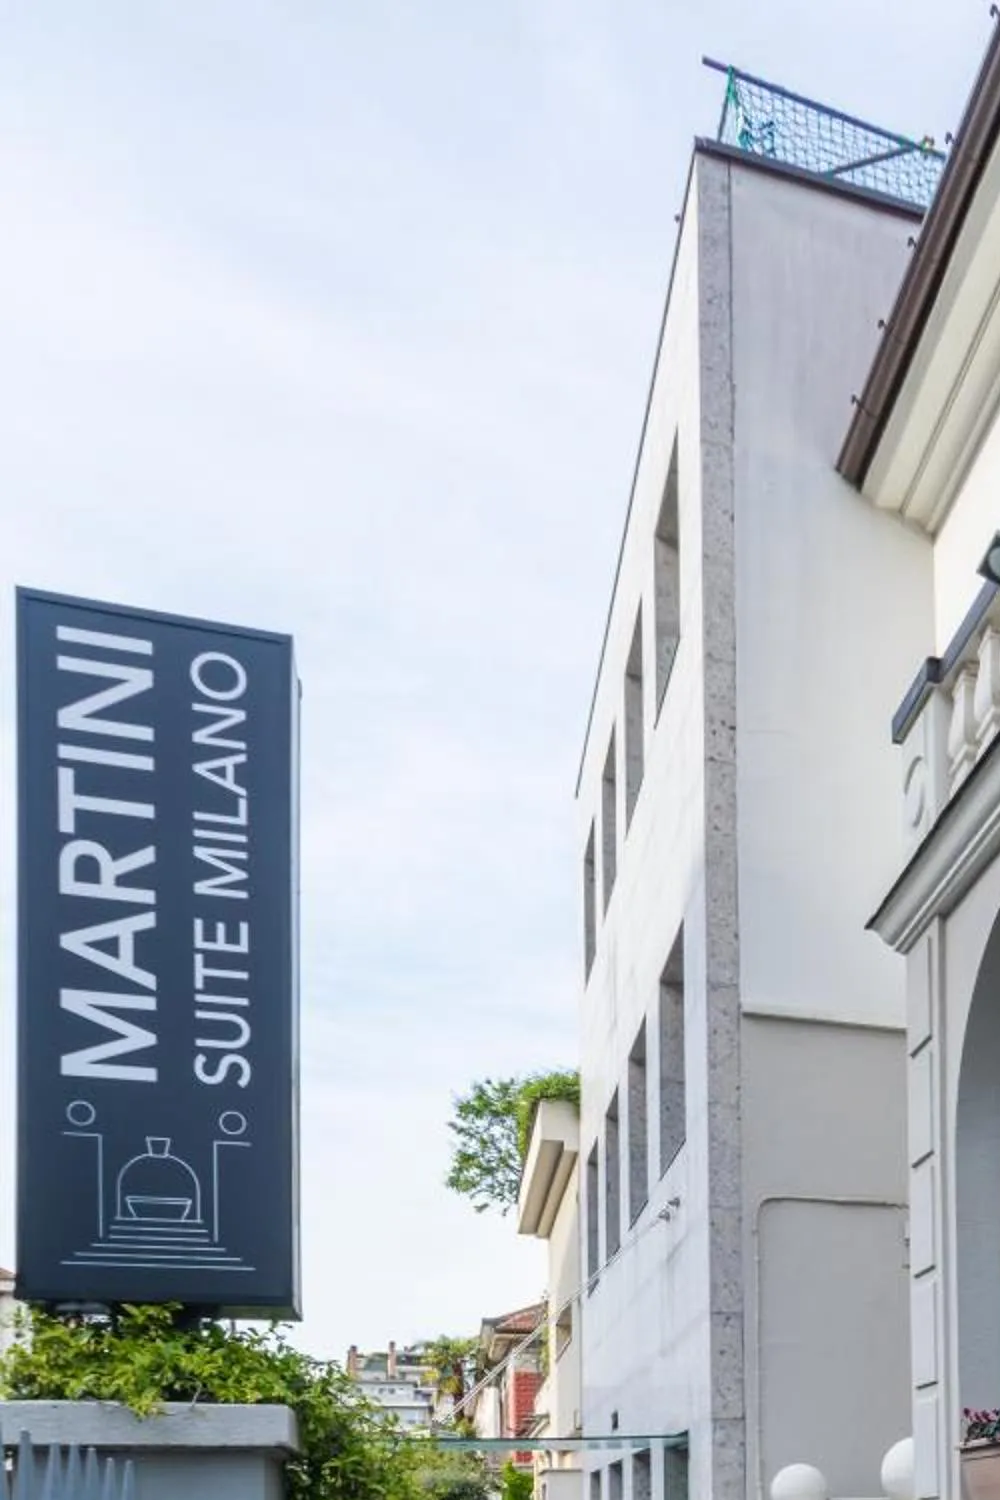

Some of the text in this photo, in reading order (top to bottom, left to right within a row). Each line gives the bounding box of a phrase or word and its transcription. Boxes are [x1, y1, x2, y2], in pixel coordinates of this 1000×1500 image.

[55, 625, 157, 1082] MARTINI
[189, 651, 251, 1088] SUITE MILANO
